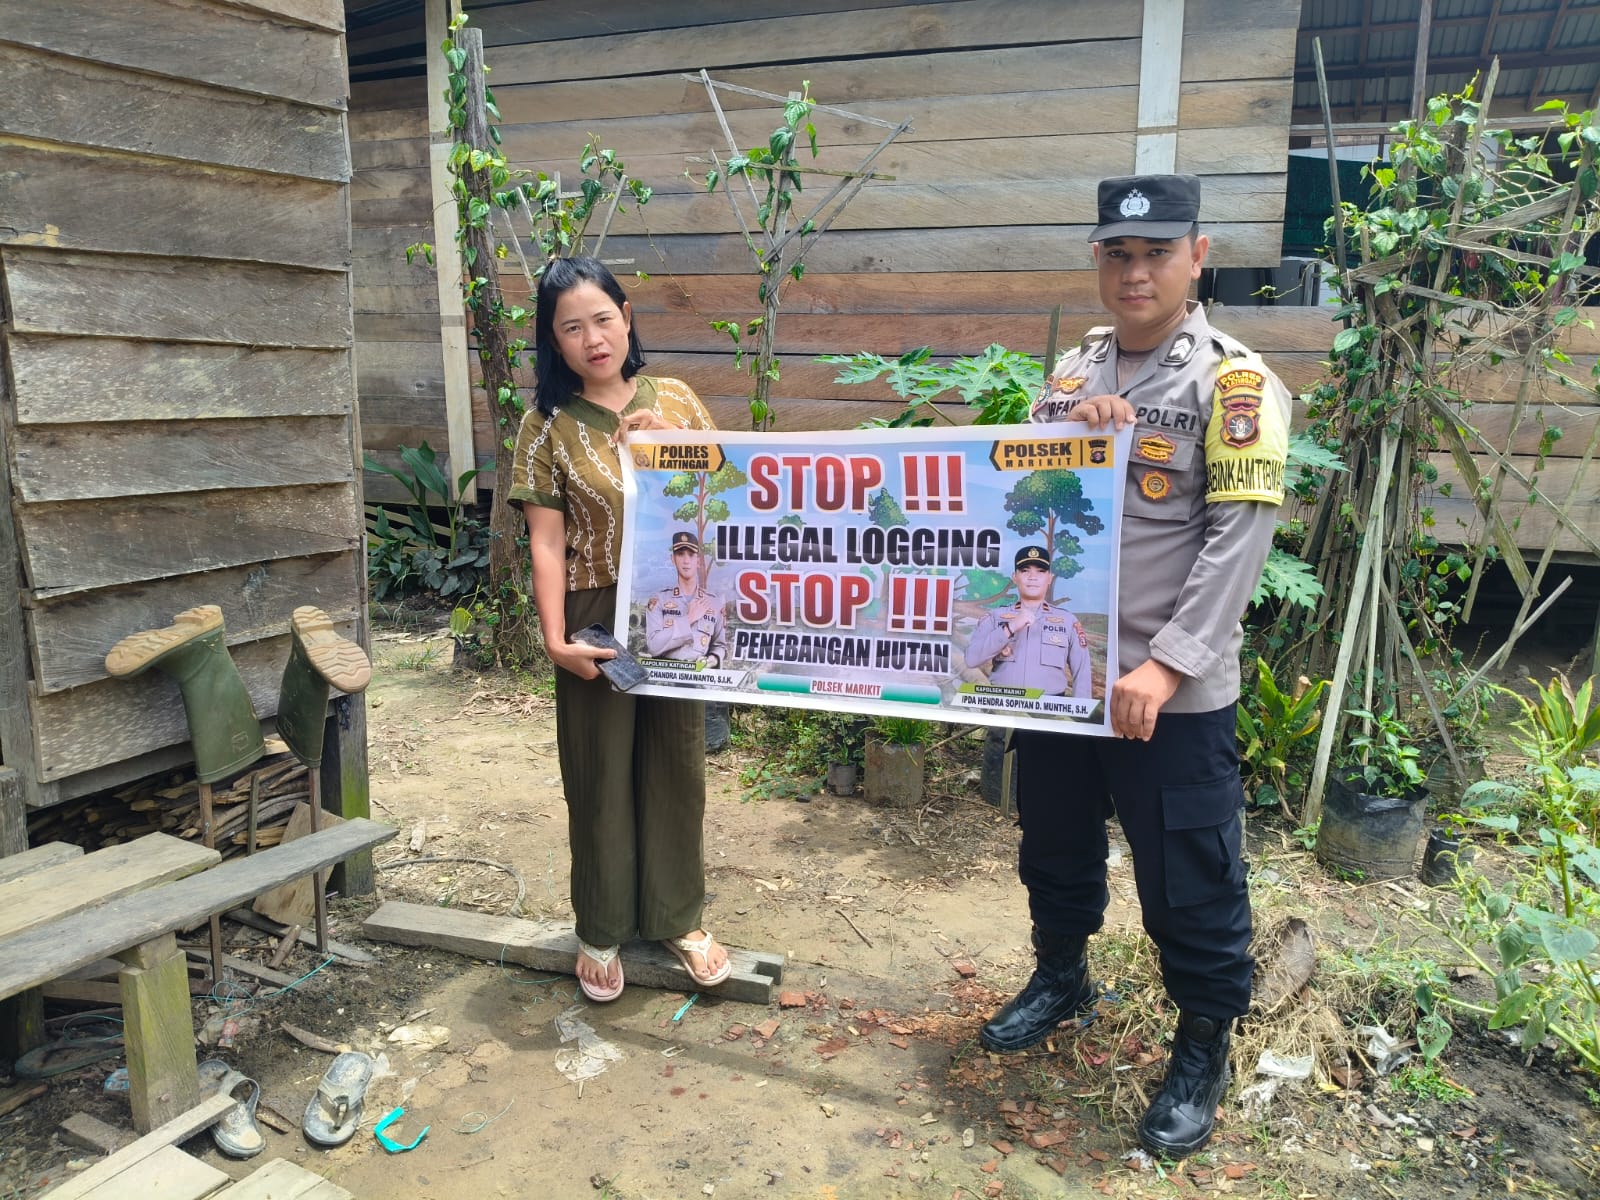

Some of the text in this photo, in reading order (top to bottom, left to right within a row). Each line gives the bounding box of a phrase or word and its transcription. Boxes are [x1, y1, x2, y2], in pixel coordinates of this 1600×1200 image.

[1136, 406, 1197, 431] POLRI
[659, 445, 709, 459] POLRES
[1003, 442, 1072, 458] POLSEK
[658, 459, 709, 470] KATINGAN
[1005, 458, 1072, 468] MARIKIT
[749, 455, 964, 512] STOP !!!
[716, 525, 1001, 568] ILLEGAL LOGGING
[738, 571, 951, 632] STOP !!!
[1043, 625, 1066, 633] POLRI
[734, 631, 949, 673] PENEBANGAN HUTAN
[650, 671, 677, 680] CHANDRA
[717, 677, 733, 685] S.I.K.
[811, 680, 881, 697] POLSEK MARIKIT
[961, 696, 1089, 715] IPDA HENDRA SOPIYAN D. MUNTHE, S.H.
